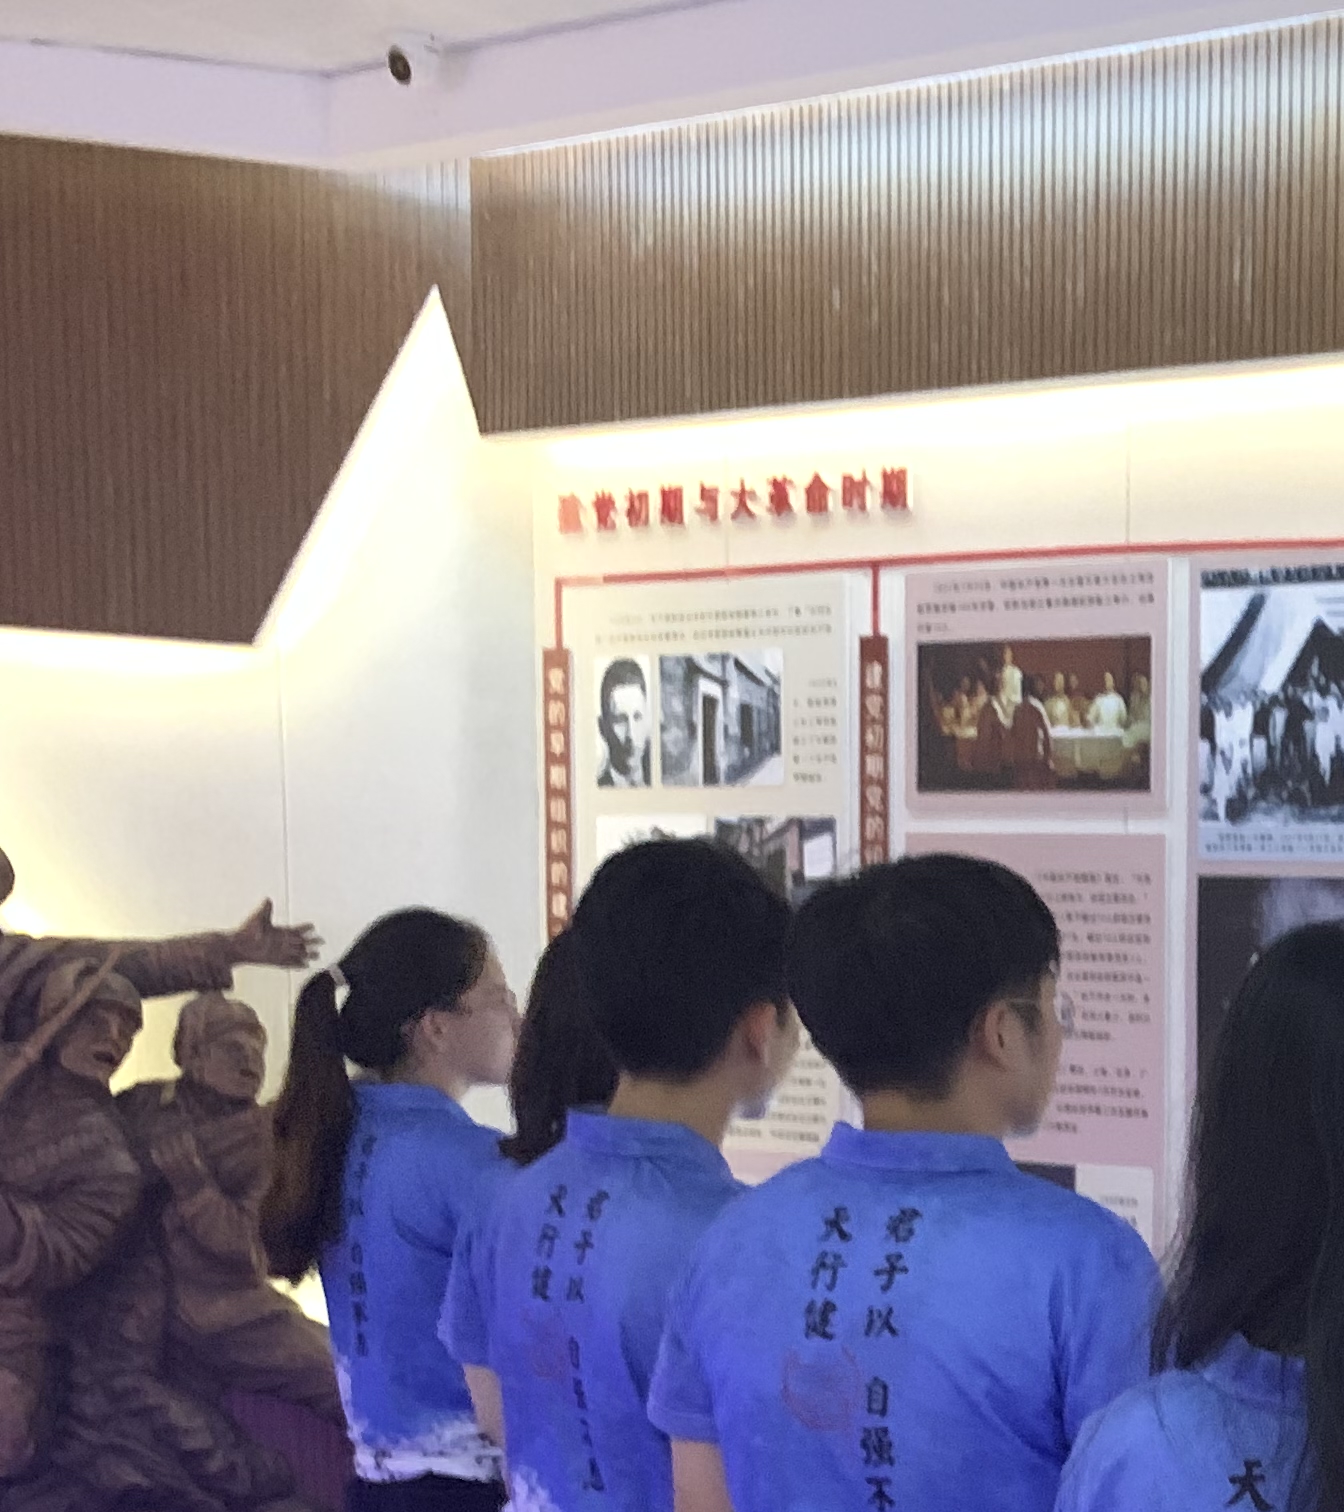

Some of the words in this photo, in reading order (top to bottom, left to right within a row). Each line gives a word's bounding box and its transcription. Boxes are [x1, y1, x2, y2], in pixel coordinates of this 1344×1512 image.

[803, 1206, 853, 1342] 天行健
[864, 1207, 922, 1340] 君子以
